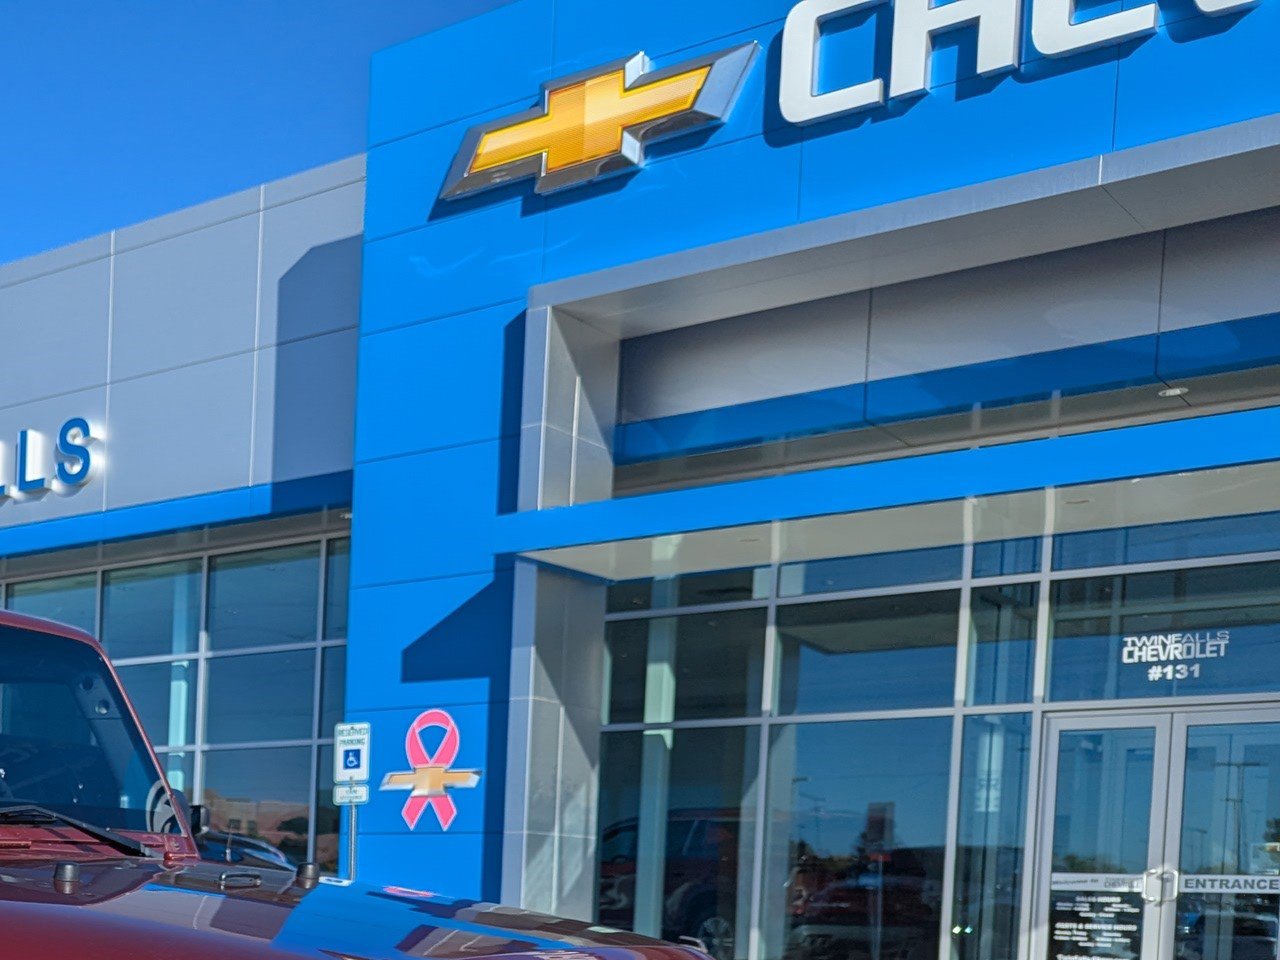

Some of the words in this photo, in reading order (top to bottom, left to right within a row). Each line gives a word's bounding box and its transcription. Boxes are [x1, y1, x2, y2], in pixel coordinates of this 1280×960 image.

[778, 0, 1262, 124] CH
[1122, 641, 1229, 664] CHEVROLET
[1147, 663, 1201, 681] #131
[1184, 878, 1280, 891] ENTRANCE
